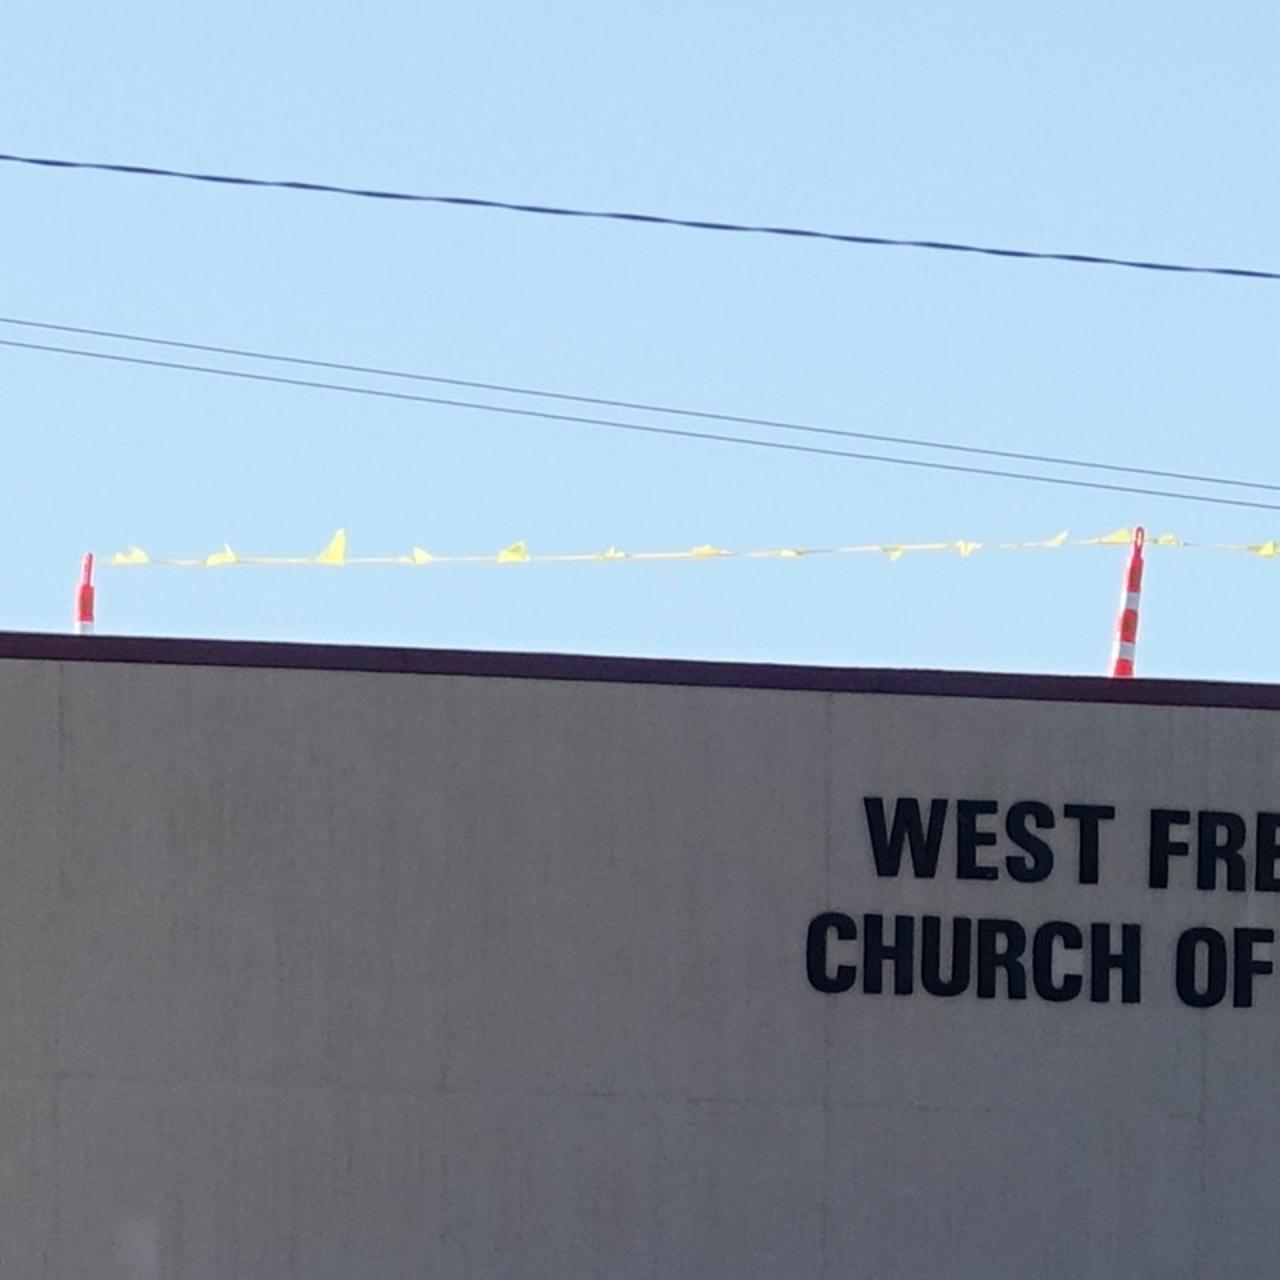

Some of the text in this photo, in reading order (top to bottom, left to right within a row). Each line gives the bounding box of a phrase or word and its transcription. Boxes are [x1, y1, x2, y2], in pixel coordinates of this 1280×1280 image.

[863, 796, 1115, 886] WEST
[805, 911, 1142, 1004] CHURCH
[1174, 926, 1275, 1009] OF
